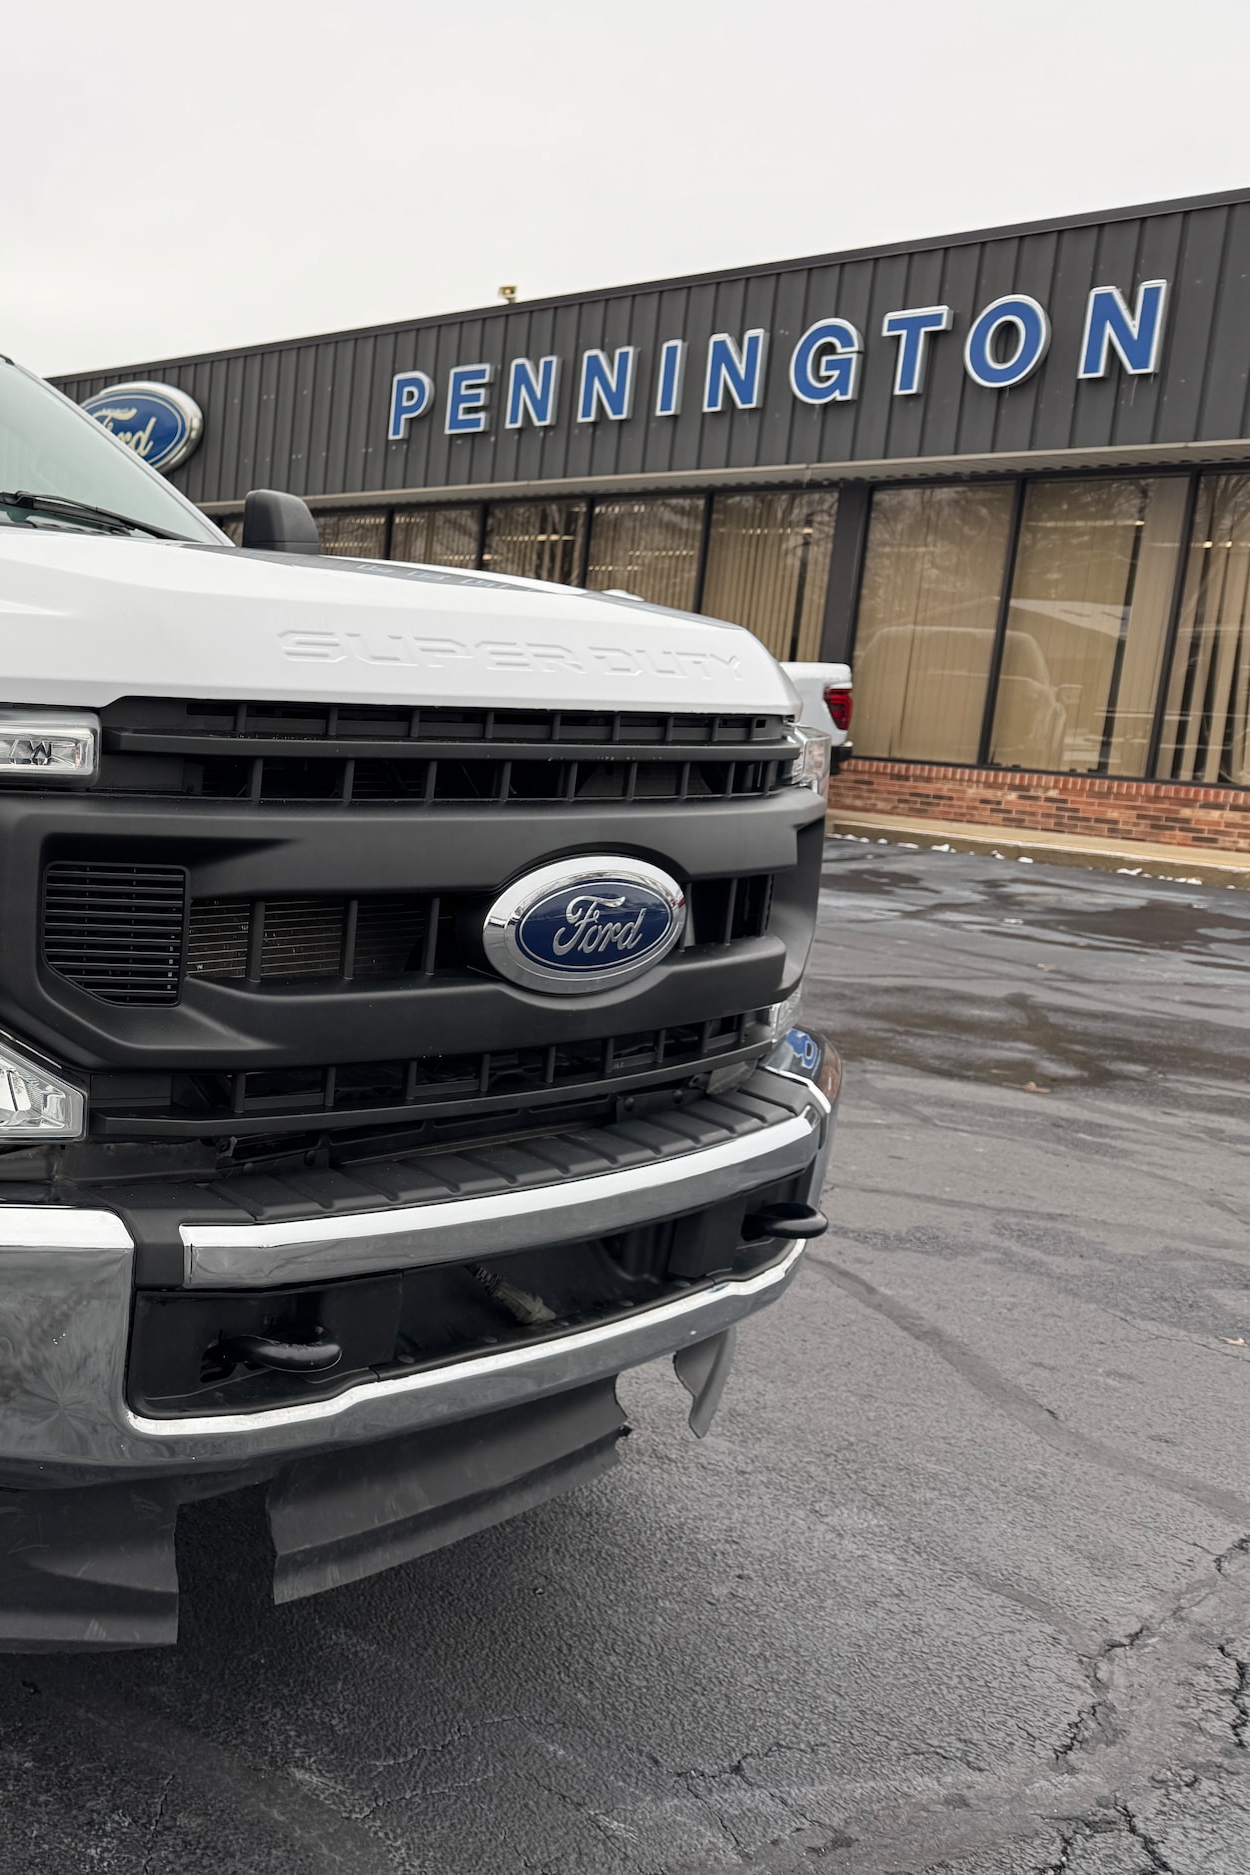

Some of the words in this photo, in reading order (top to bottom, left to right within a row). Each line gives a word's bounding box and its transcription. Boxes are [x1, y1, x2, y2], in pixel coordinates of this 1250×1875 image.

[387, 278, 1169, 440] PENNINGTON
[91, 407, 157, 457] Frd
[277, 629, 586, 675] SUPER
[588, 646, 743, 682] DUTY
[553, 896, 647, 956] Ford
